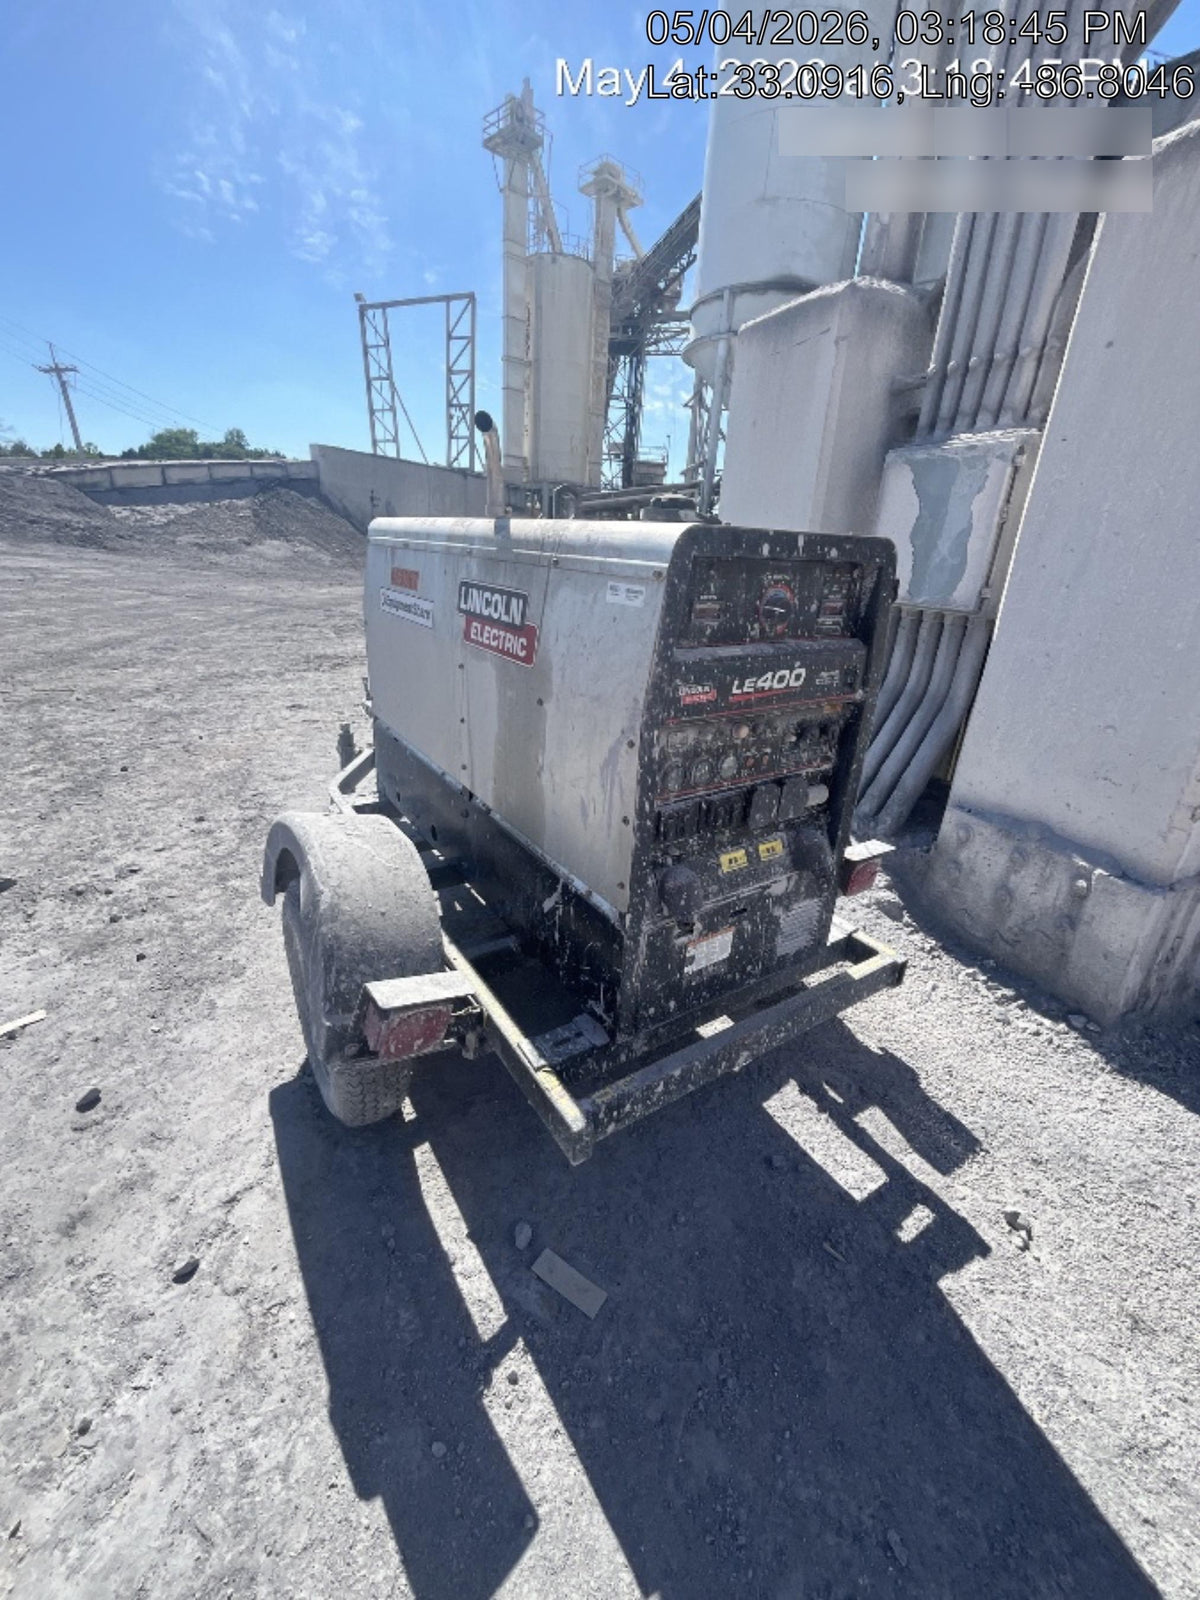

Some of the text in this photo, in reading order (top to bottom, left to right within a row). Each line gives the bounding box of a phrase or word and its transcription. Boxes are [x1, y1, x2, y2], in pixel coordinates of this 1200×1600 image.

[460, 586, 523, 626] LINCOLN
[470, 621, 527, 657] ELECTRIC
[732, 667, 806, 694] LE400
